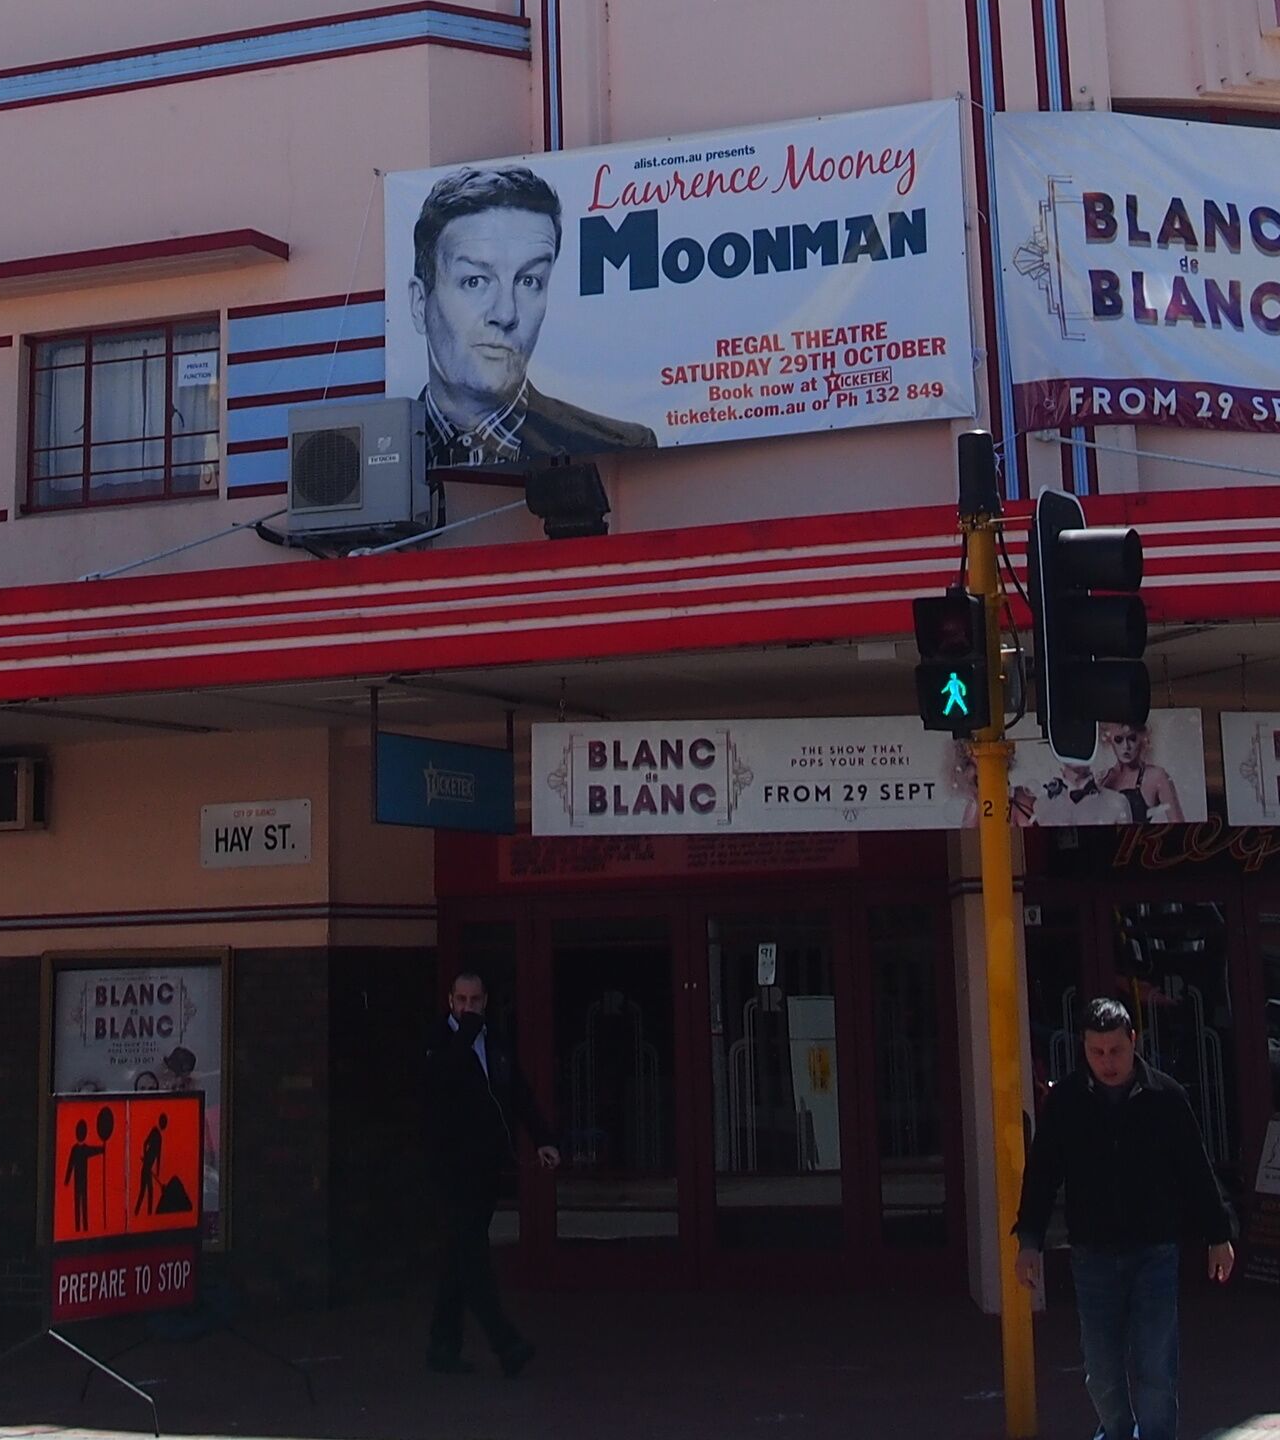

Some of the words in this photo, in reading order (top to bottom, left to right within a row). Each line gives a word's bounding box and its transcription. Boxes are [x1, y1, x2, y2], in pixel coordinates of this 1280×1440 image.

[634, 153, 702, 170] alist.com.au
[706, 145, 756, 162] presents
[588, 164, 768, 212] Lawrence
[771, 144, 915, 196] Mooney
[579, 208, 927, 297] MOONMAN
[1179, 255, 1199, 273] de
[716, 334, 785, 357] REGAL
[791, 322, 887, 350] THEATRE
[661, 357, 772, 385] SATURDAY
[779, 351, 836, 374] 29TH
[844, 337, 946, 367] OCTOBER
[708, 383, 753, 401] Book
[760, 383, 794, 397] now
[800, 377, 817, 392] at
[826, 369, 890, 391] TICKETEK
[666, 401, 806, 426] ticketek.com.au
[812, 399, 829, 411] or
[836, 391, 858, 409] Ph
[865, 386, 900, 405] 132
[906, 381, 944, 400] 849
[1070, 387, 1177, 415] FROM
[1194, 391, 1234, 420] 29
[588, 738, 716, 771] BLANC
[790, 758, 824, 768] POPS
[830, 757, 865, 767] YOUR
[871, 756, 910, 766] CORK!
[801, 745, 823, 756] THE
[830, 745, 866, 755] SHOW
[872, 744, 903, 754] THAT
[588, 783, 717, 816] BLANC
[764, 784, 831, 803] FROM
[843, 784, 868, 801] 29
[880, 783, 936, 801] SEPT
[983, 800, 993, 817] 2
[215, 826, 253, 853] HAY
[264, 823, 295, 850] ST.
[95, 982, 175, 1008] BLANC
[95, 1015, 174, 1041] BLANC
[58, 1267, 127, 1306] PREPARE
[134, 1264, 152, 1296] TO
[157, 1259, 192, 1293] STOP
